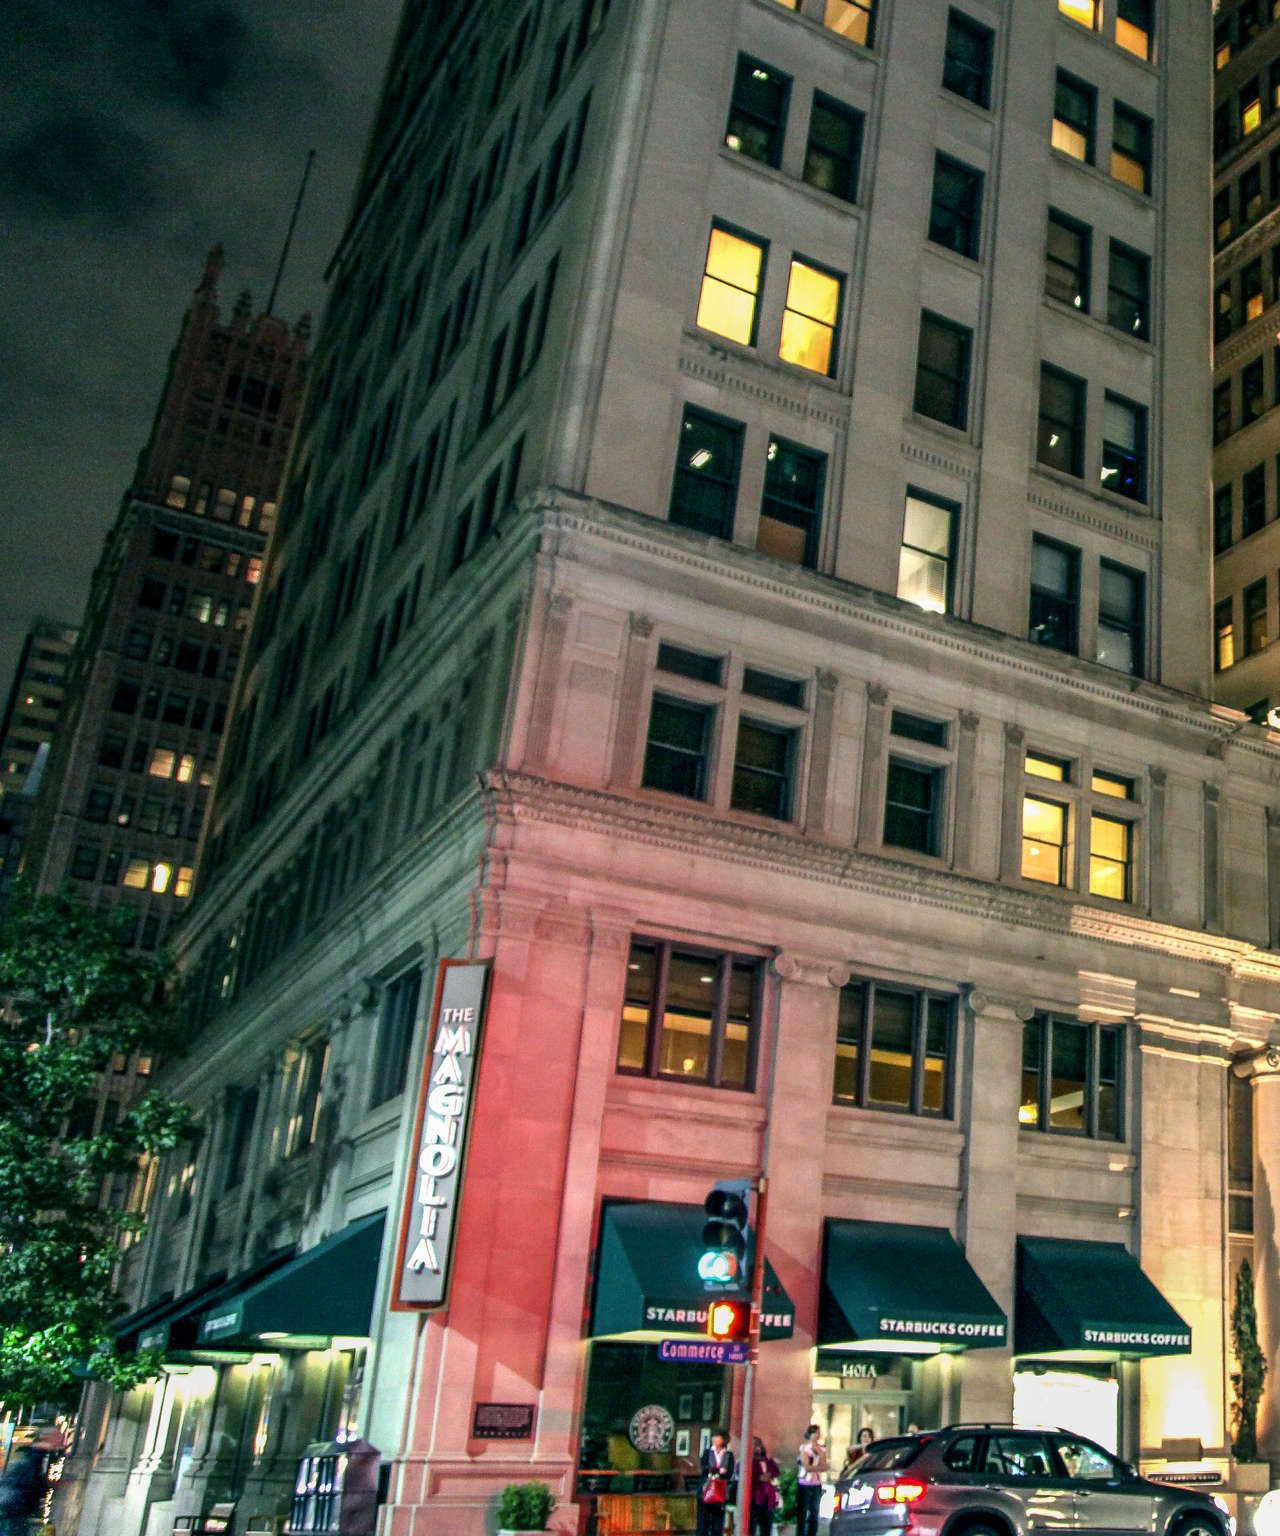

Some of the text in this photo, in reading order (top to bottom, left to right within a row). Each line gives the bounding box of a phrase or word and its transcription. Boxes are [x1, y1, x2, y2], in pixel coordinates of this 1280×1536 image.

[443, 1007, 475, 1023] THE
[406, 1025, 472, 1275] MAGNOLIA
[646, 1307, 708, 1323] STARBU
[880, 1318, 1005, 1337] STARBUCKS COFFEE
[1084, 1329, 1190, 1346] STARBUCKS COFFEE
[662, 1341, 725, 1360] Commerce
[842, 1363, 877, 1378] 1401A
